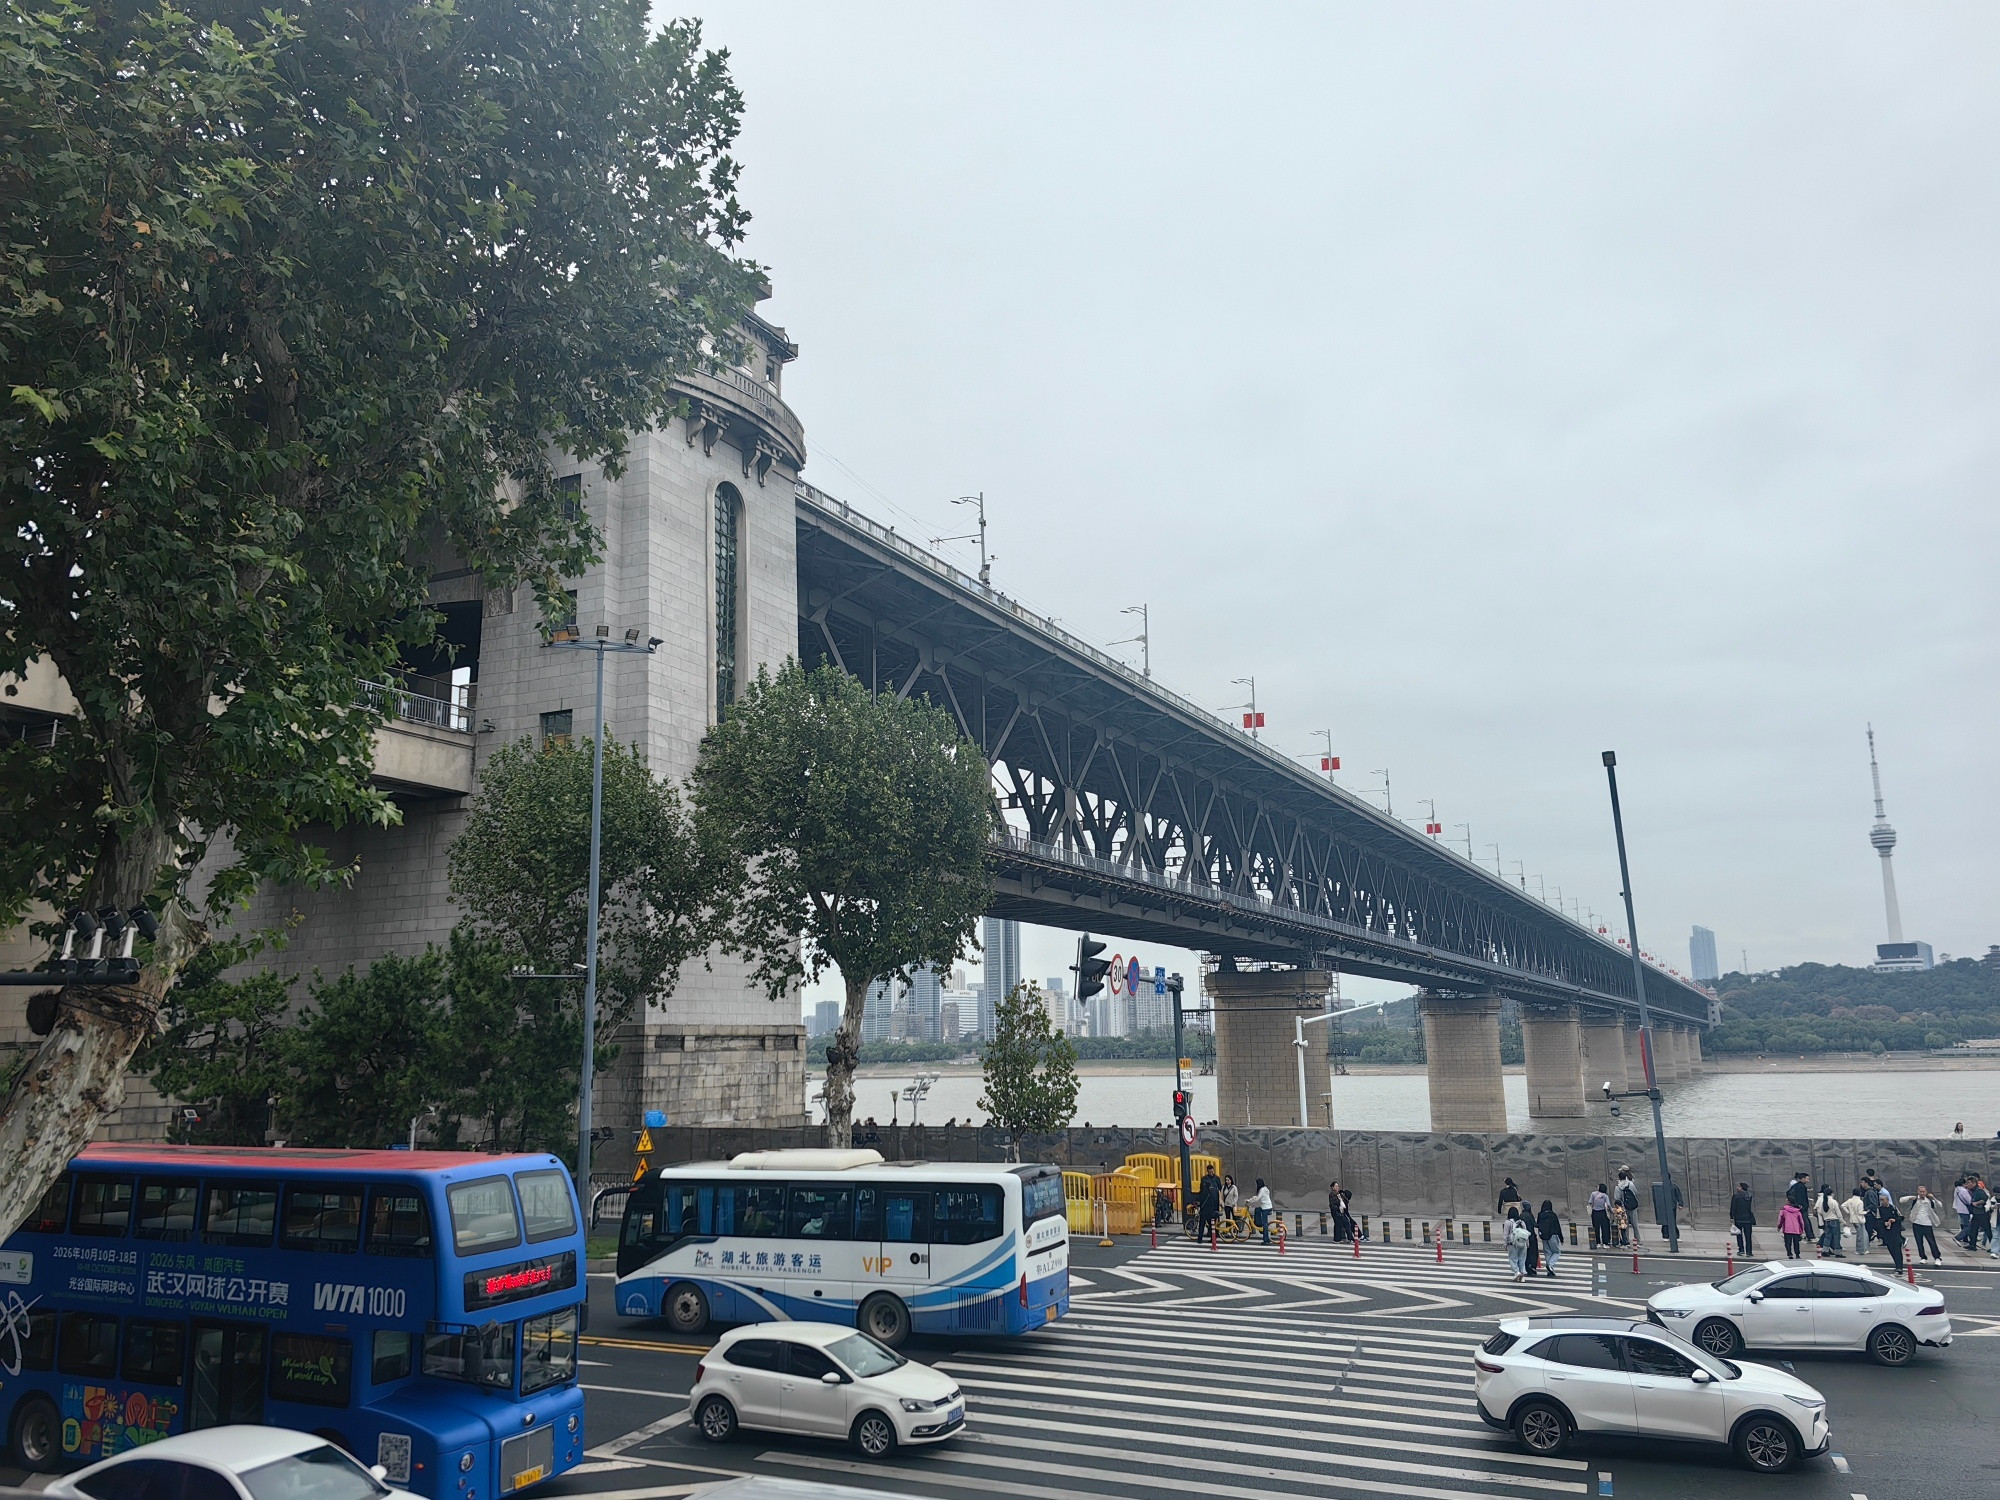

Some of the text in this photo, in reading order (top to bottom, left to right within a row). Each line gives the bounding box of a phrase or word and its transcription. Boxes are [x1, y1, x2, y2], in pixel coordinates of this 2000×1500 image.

[1113, 965, 1122, 983] 30
[53, 1246, 137, 1265] 2026年10月10日-18日
[721, 1250, 822, 1268] 湖北旅游客运
[862, 1256, 893, 1273] VIP
[69, 1276, 135, 1295] 光谷国际网球中心
[146, 1270, 290, 1306] 武汉网球公开赛
[313, 1282, 406, 1318] WTA 1000
[217, 1303, 257, 1317] WUHAN
[258, 1307, 287, 1319] OPEN
